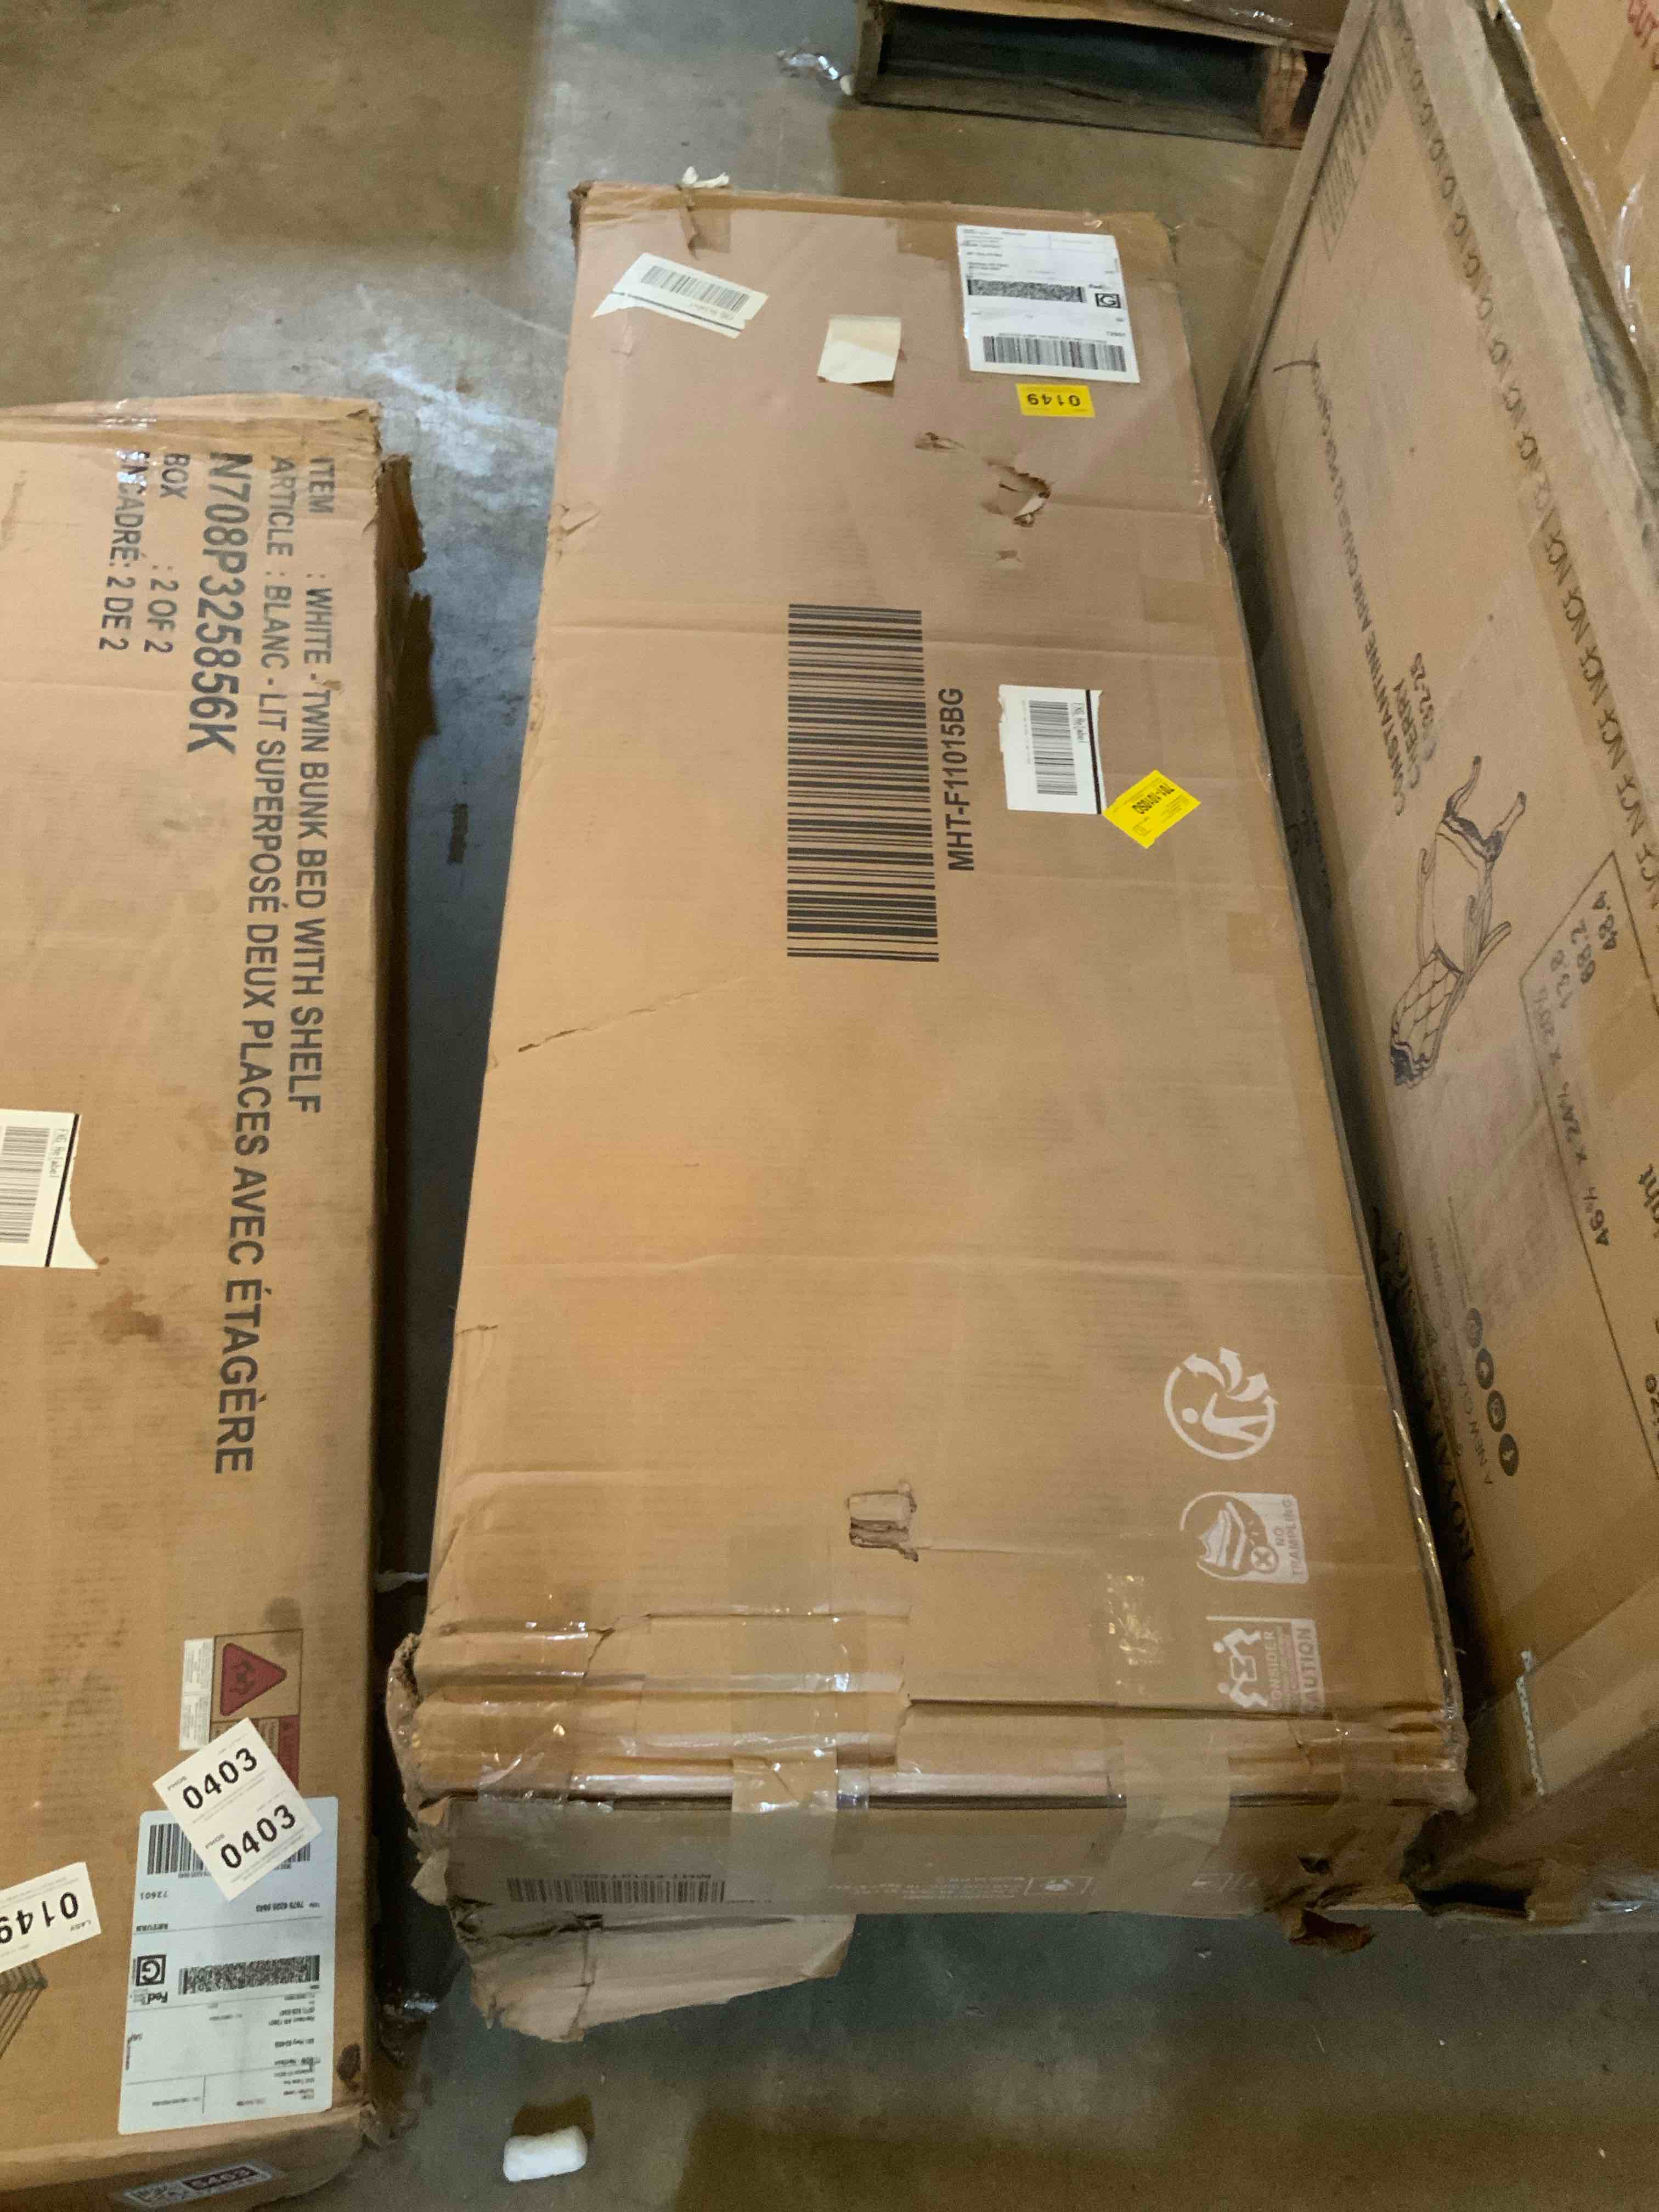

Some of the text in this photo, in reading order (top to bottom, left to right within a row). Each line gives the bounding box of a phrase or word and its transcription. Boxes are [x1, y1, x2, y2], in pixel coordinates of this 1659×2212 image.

[1027, 393, 1081, 408] 0149
[159, 453, 191, 500] BOX
[267, 455, 297, 556] ARTICLE
[309, 456, 335, 514] ITEM
[101, 597, 134, 630] DE
[105, 577, 136, 590] 2
[147, 599, 178, 631] OF
[150, 577, 179, 593] 2
[187, 452, 254, 755] N708P325856K
[99, 637, 128, 652] 2
[144, 639, 173, 654] 2
[261, 584, 292, 669] BLANC
[303, 588, 333, 664] WHITE
[257, 693, 289, 731] LIT
[300, 690, 331, 752] TWIN
[297, 762, 329, 839] BUNK
[939, 688, 975, 871] MHT-F11015BG
[248, 739, 289, 913] SUPERPOSÉ
[295, 849, 327, 909] BED
[243, 924, 278, 1009] DEUX
[292, 918, 326, 996] WITH
[234, 1020, 274, 1156] PLACES
[289, 1006, 324, 1114] SHELF
[227, 1165, 267, 1266] AVEC
[215, 1279, 272, 1474] ÉTAGÈRE
[1282, 1498, 1304, 1577] TRAMPLING
[182, 1747, 258, 1810] 0403
[221, 1804, 296, 1869] 0403
[142, 1960, 161, 1983] G
